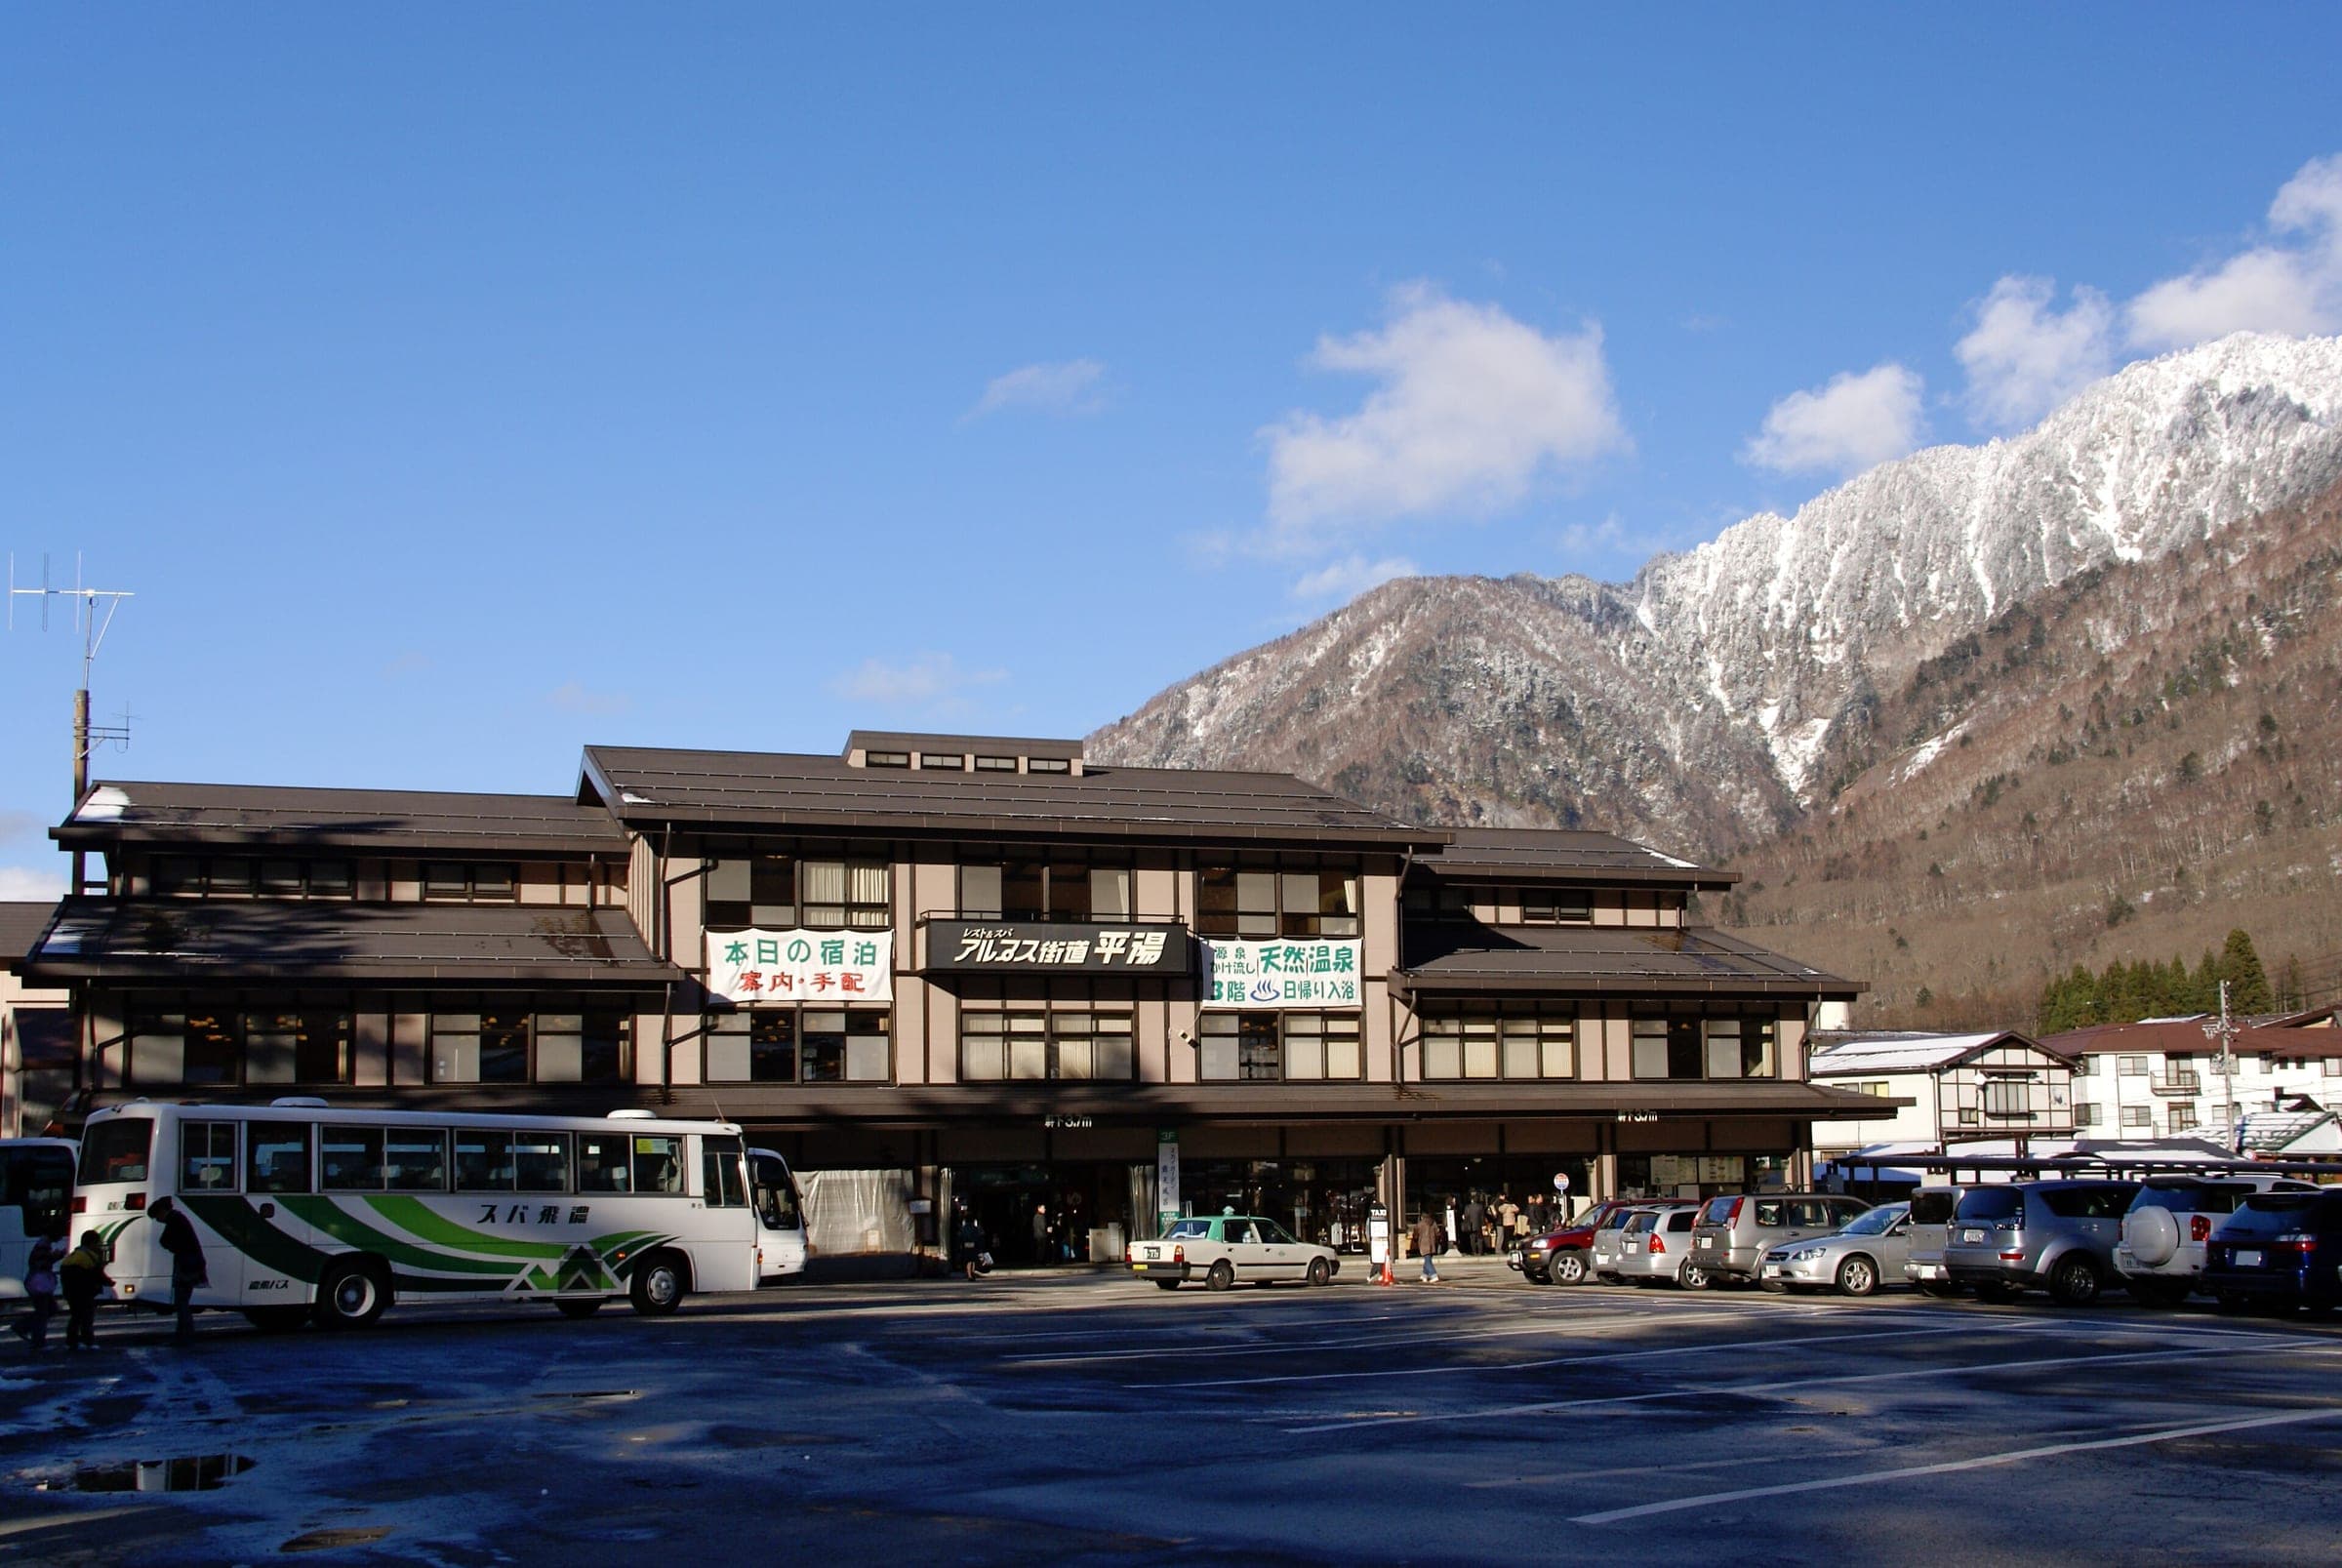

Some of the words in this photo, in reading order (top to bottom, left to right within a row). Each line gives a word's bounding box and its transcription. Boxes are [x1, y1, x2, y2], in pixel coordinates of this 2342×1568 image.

[724, 939, 877, 966] 本日の宿泊
[1095, 931, 1167, 965] 平湯
[1259, 945, 1354, 974] 天然温泉
[739, 972, 866, 993] 案内・手配
[1212, 981, 1245, 1002] 3階
[1284, 981, 1354, 1000] 日帰り入浴
